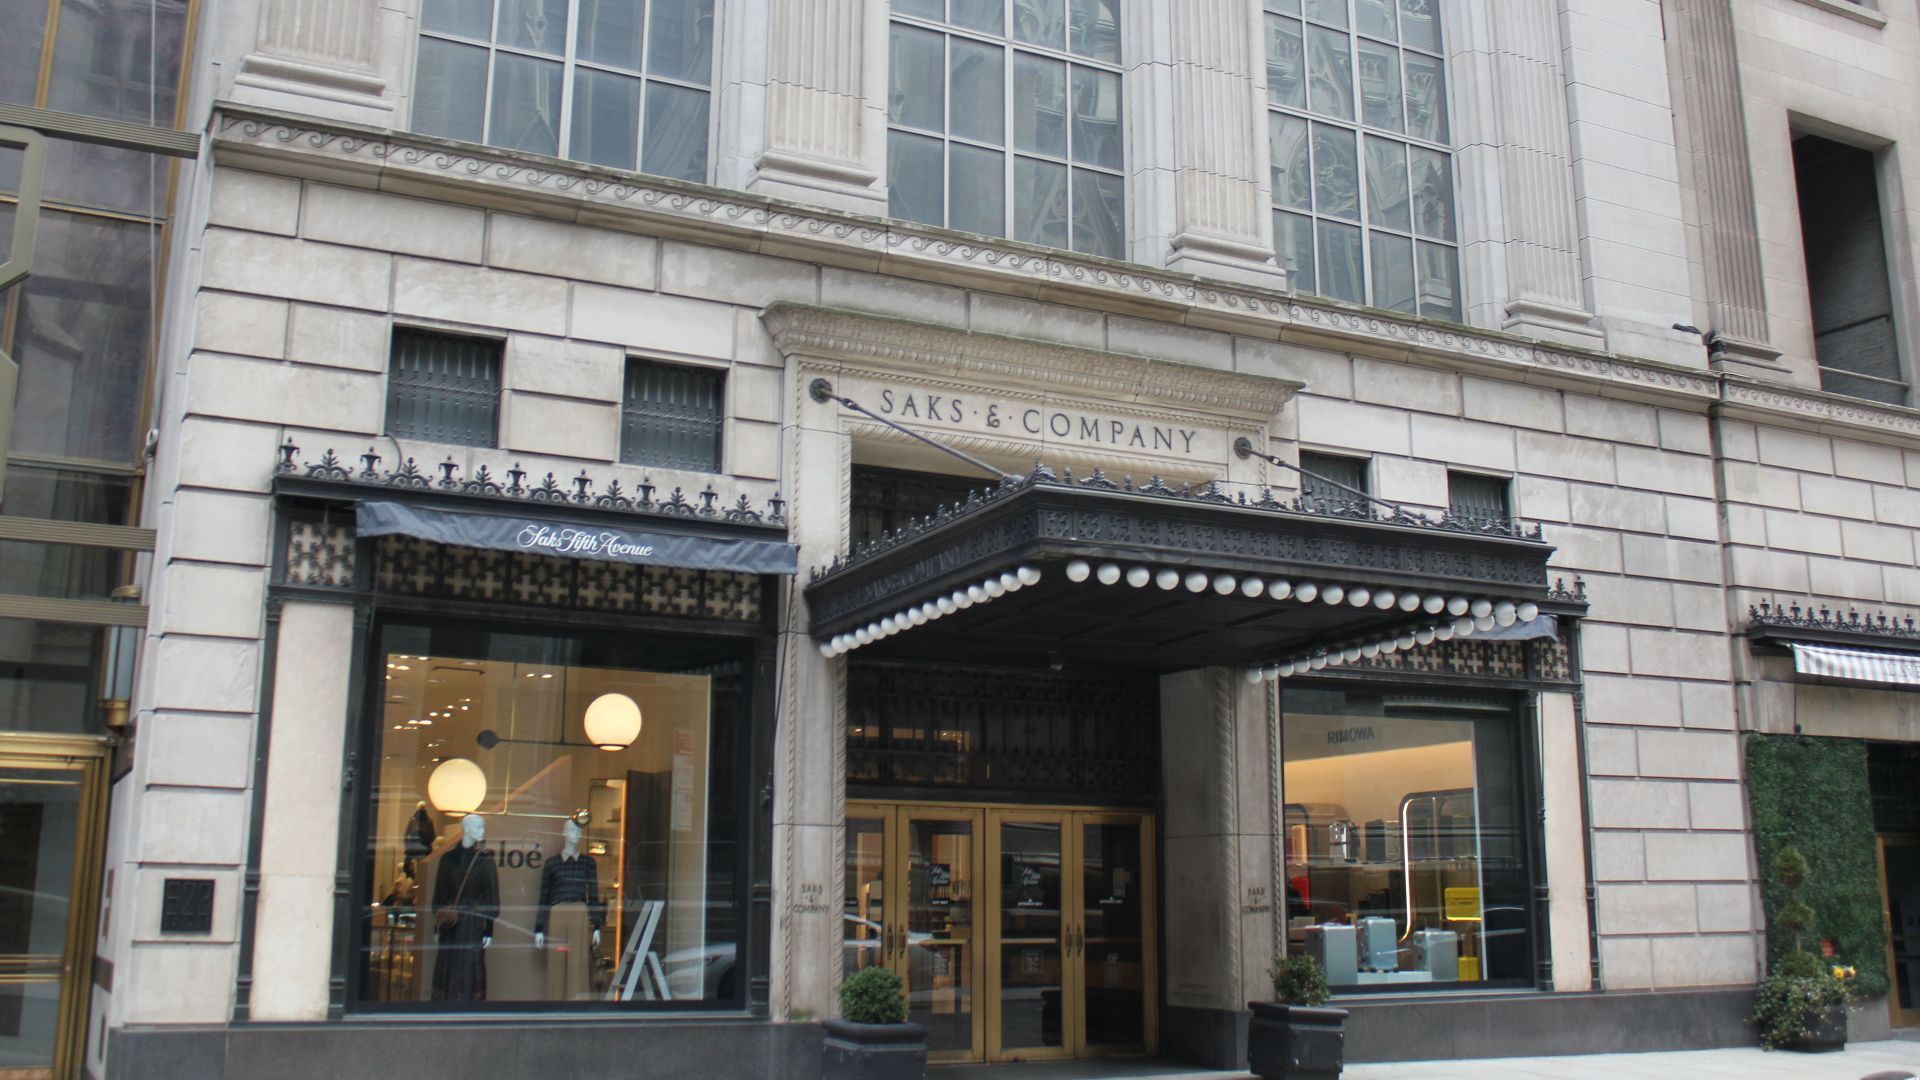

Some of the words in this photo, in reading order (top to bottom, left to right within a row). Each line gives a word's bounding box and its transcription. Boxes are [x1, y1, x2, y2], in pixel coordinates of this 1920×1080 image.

[880, 388, 963, 423] SAKS
[1022, 408, 1197, 454] COMPANY
[516, 524, 563, 549] Saks
[555, 528, 600, 553] Fifth
[588, 532, 653, 557] Avenue
[1327, 725, 1376, 745] RIMOWA
[480, 840, 543, 869] loé
